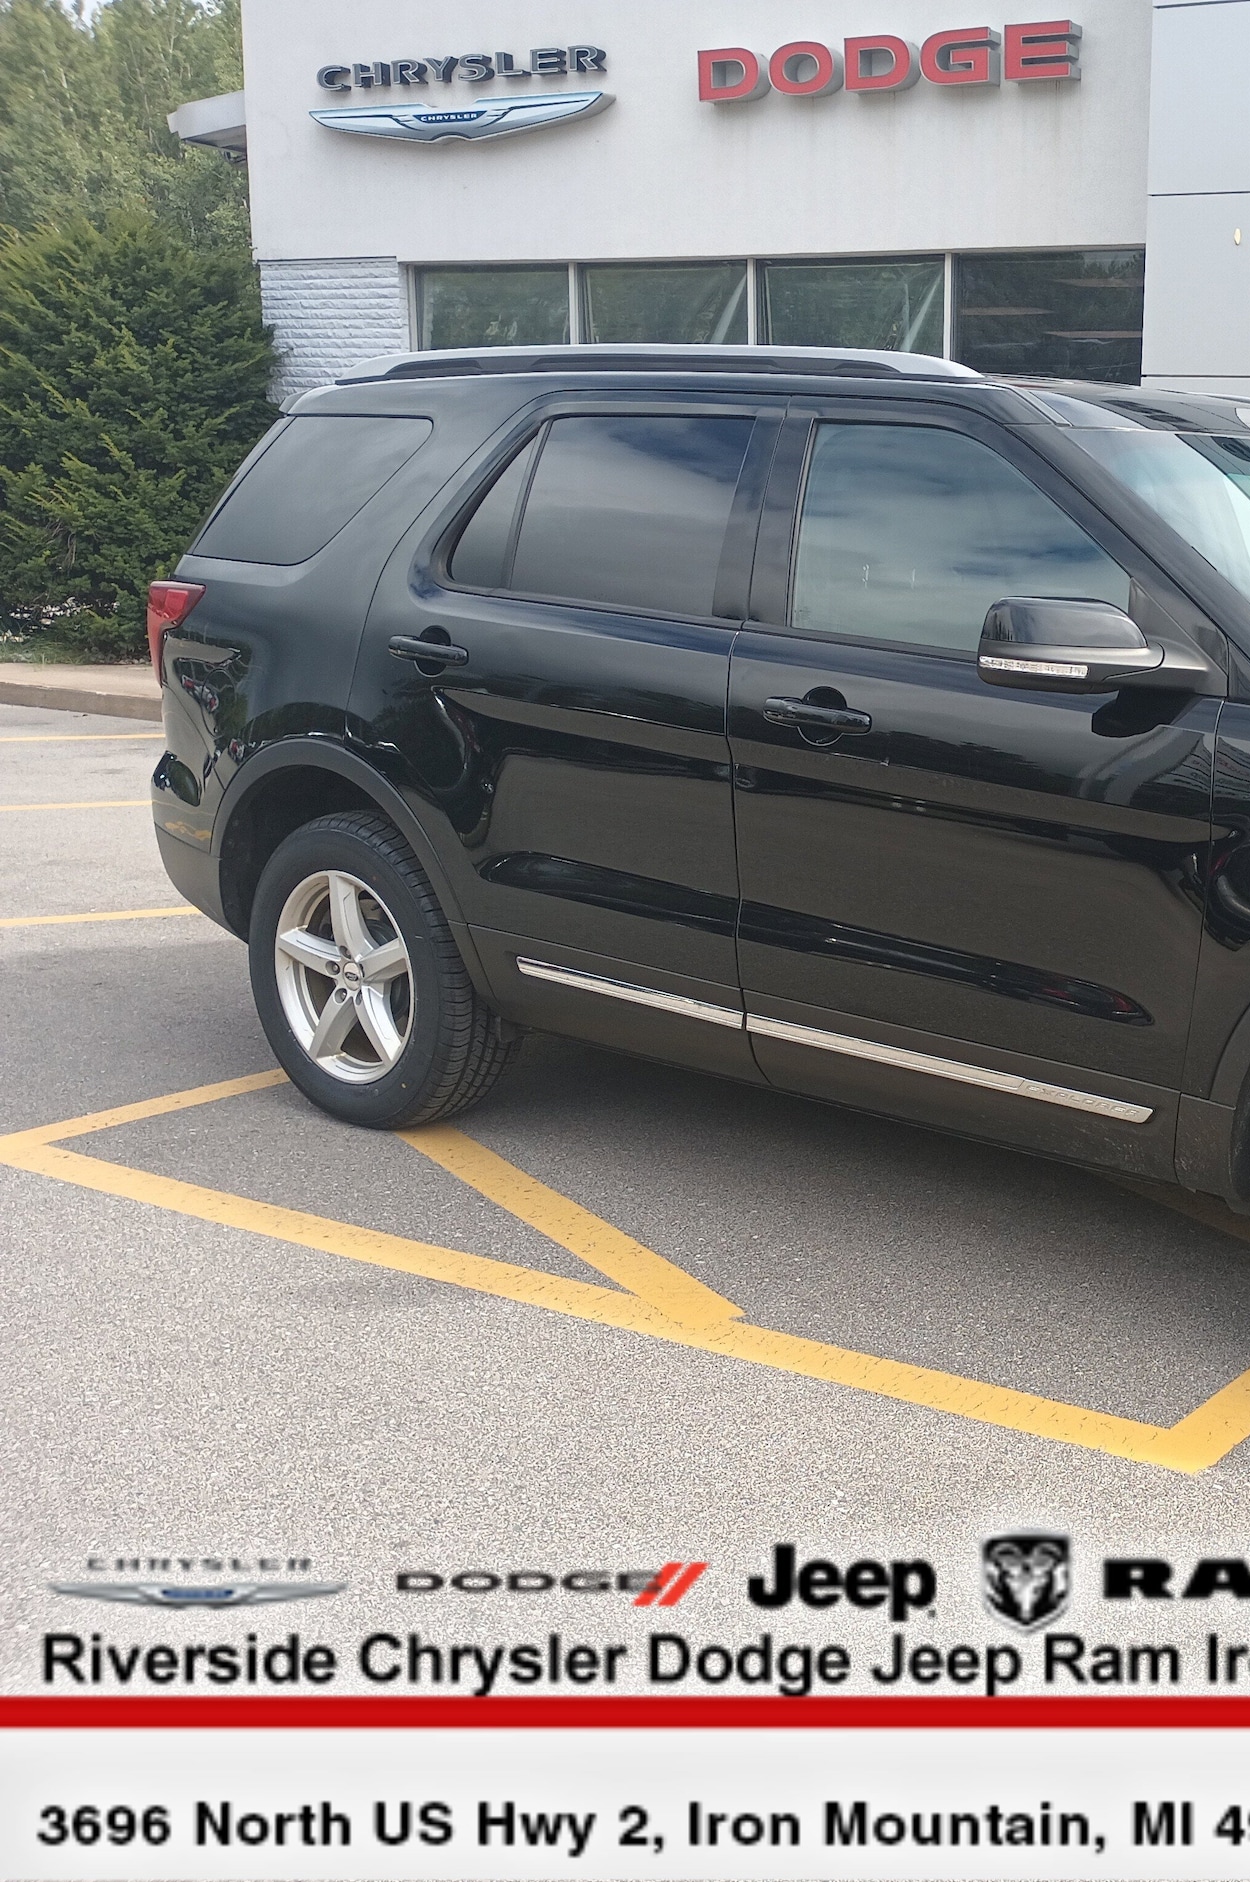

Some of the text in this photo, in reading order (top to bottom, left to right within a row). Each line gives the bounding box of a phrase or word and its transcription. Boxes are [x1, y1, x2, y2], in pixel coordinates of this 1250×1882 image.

[316, 45, 607, 91] CHRYSLER
[697, 20, 1082, 102] DODGE
[420, 112, 478, 122] CHRYSLER
